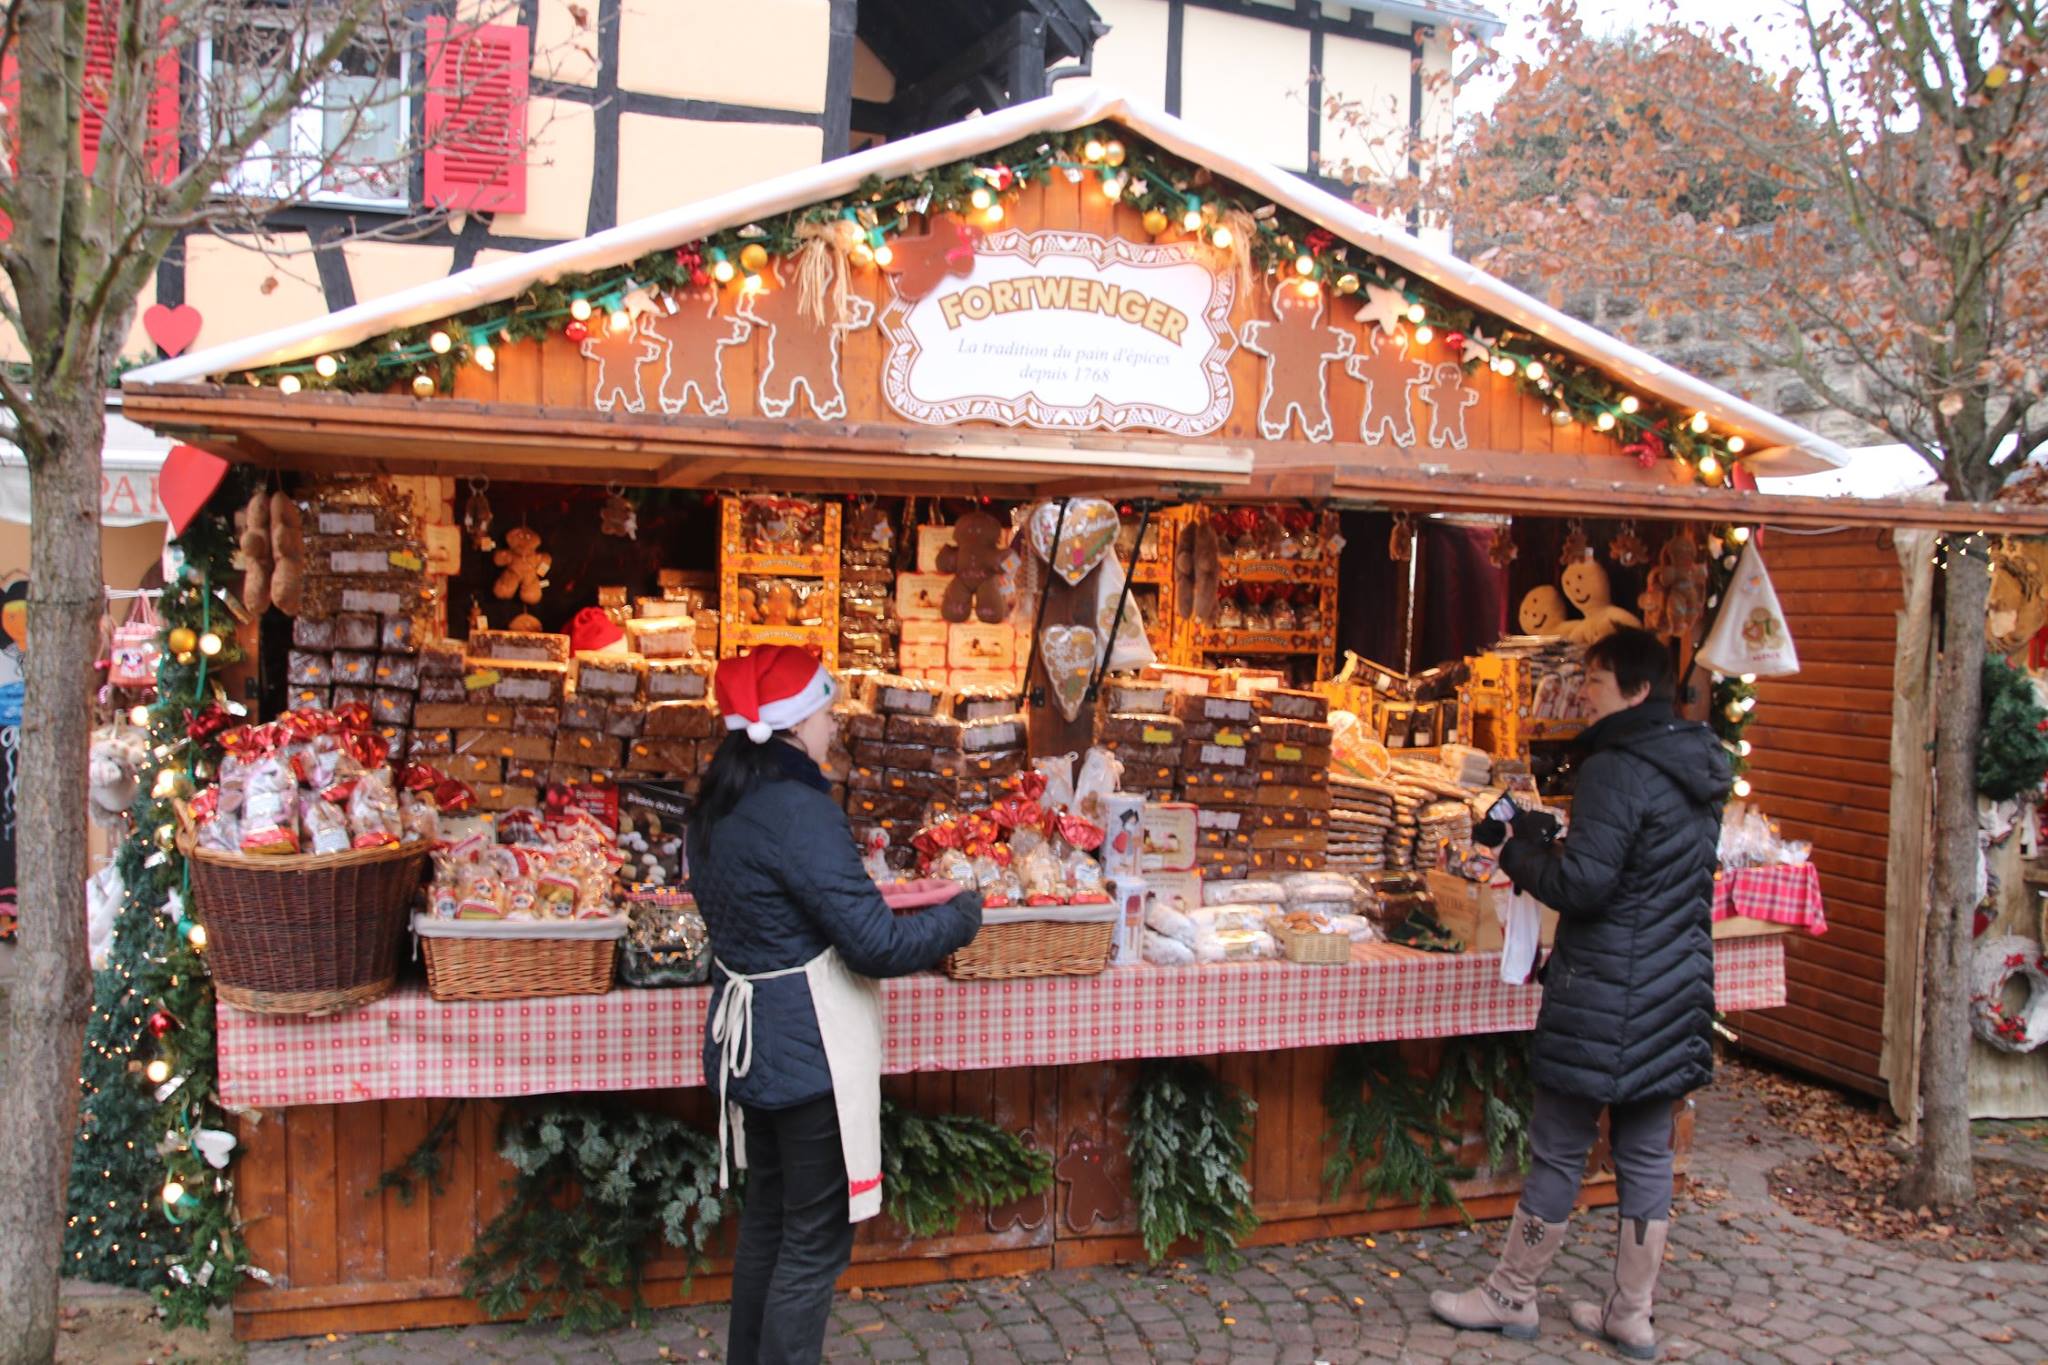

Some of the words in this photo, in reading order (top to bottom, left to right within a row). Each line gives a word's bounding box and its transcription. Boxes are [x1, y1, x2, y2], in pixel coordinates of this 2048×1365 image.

[938, 276, 1188, 346] FORTWENGER
[957, 339, 978, 354] La
[983, 340, 1047, 358] tradition
[1052, 344, 1071, 359] du
[1075, 348, 1108, 366] pain
[1112, 346, 1171, 366] d'épices
[1018, 364, 1068, 383] depuis
[1075, 366, 1111, 383] 1768
